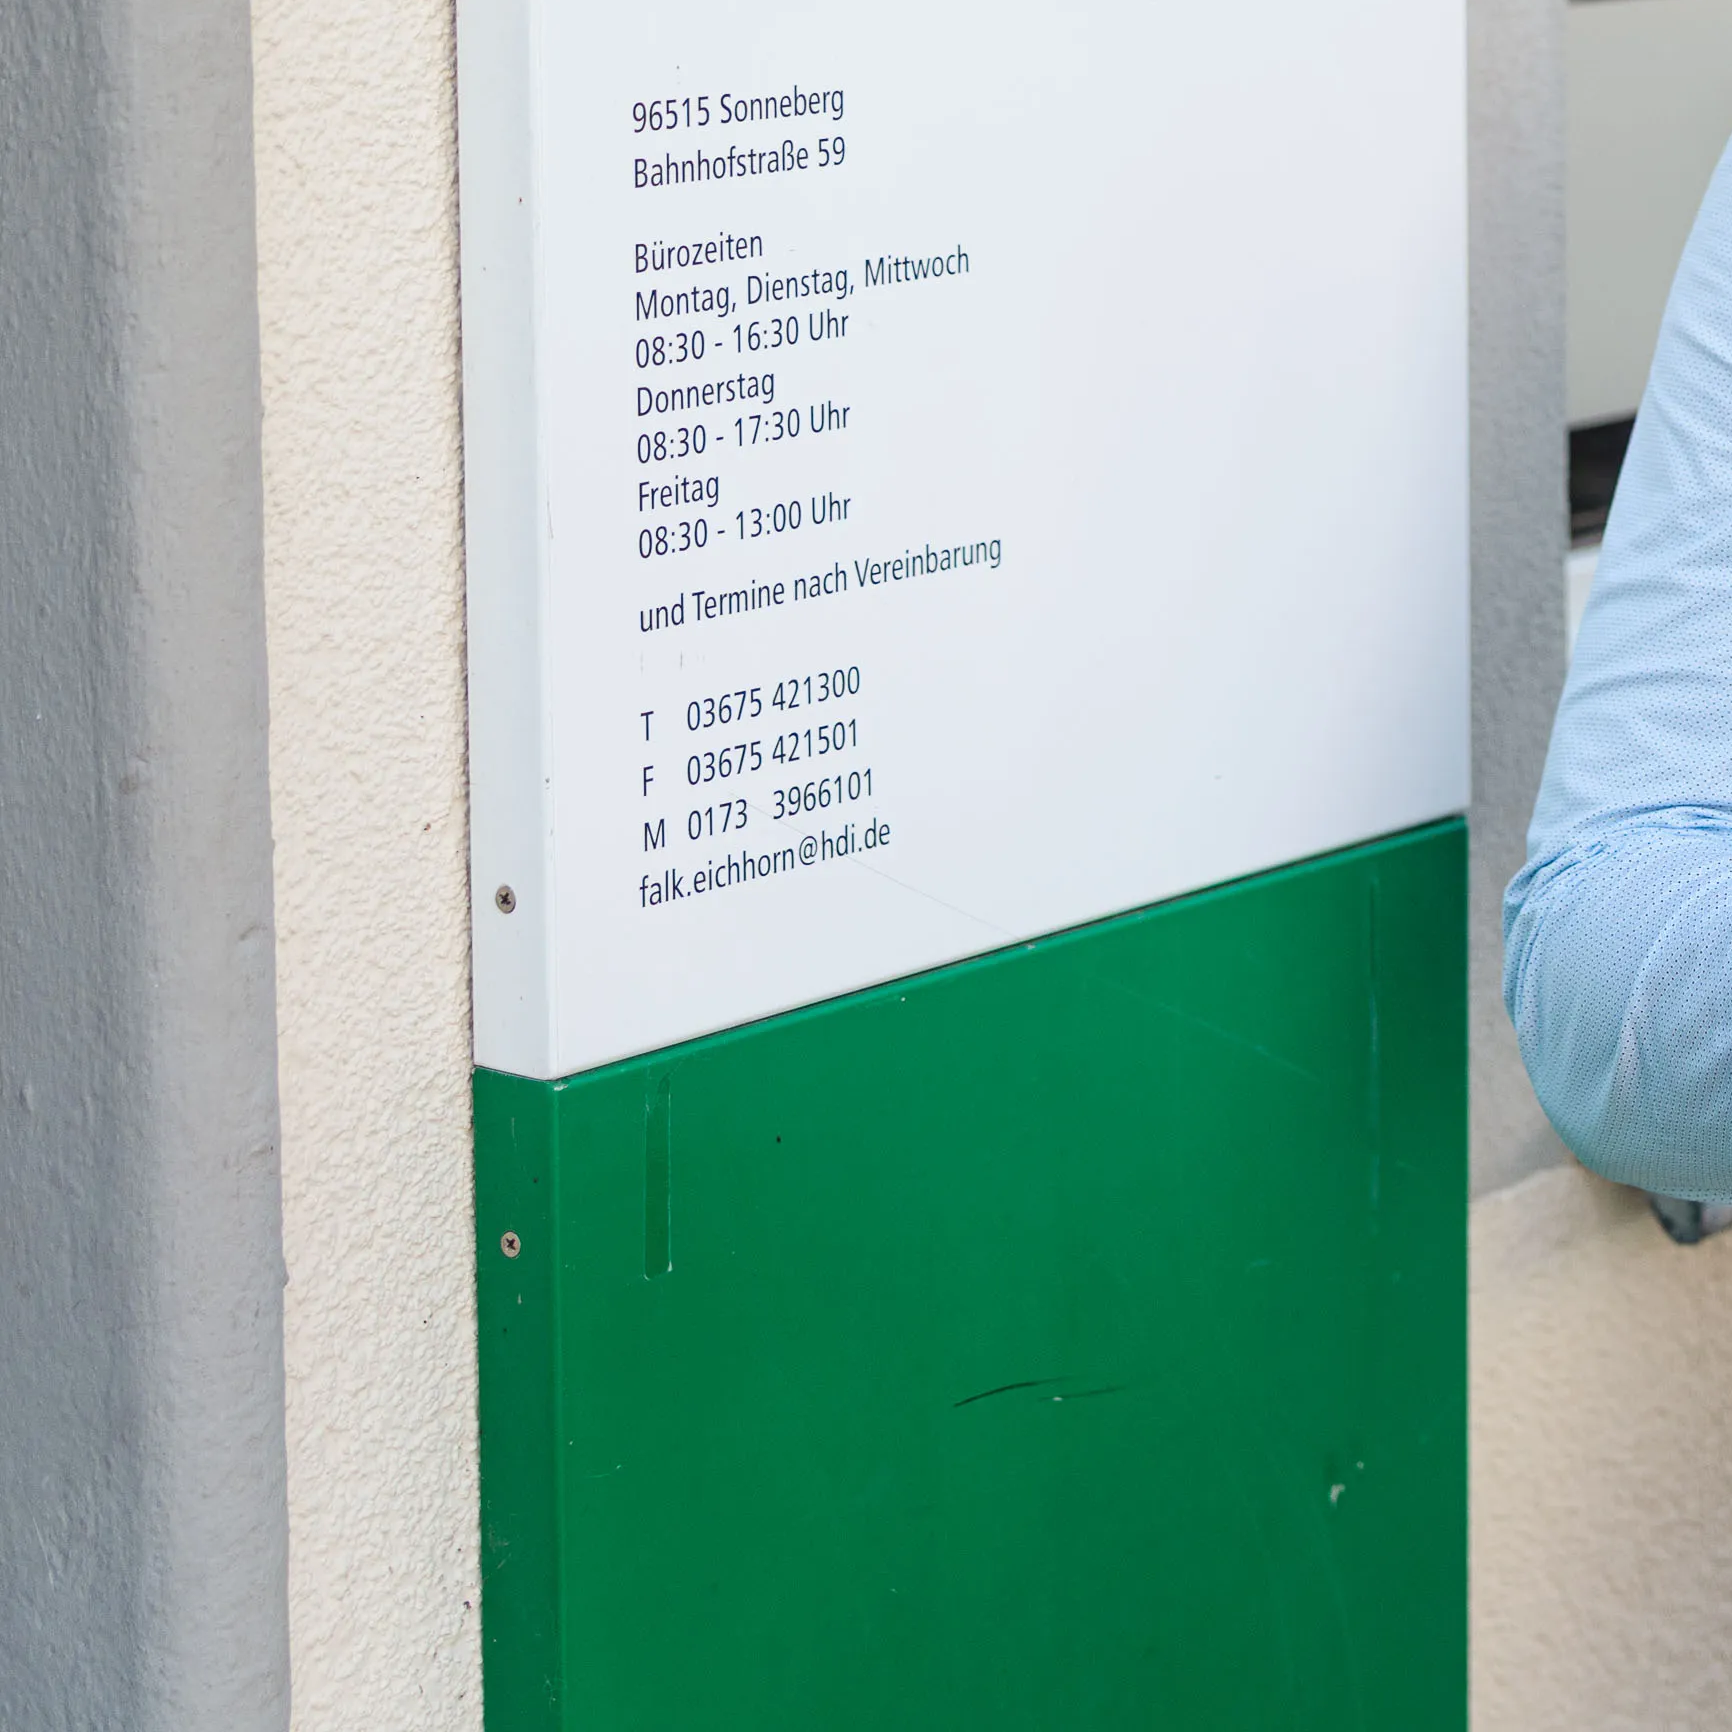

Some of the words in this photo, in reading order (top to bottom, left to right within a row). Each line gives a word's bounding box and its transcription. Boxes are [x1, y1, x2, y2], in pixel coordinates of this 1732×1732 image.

[632, 95, 710, 134] 96515
[720, 84, 845, 124] Sonneberg
[634, 139, 809, 189] Bahnhofstraße
[818, 136, 847, 168] 59
[635, 232, 763, 274] Bürozeiten
[636, 284, 737, 322] Montag,
[747, 268, 854, 305] Dienstag,
[865, 244, 970, 288] Mittwoch
[635, 329, 705, 369] 08:30
[733, 315, 799, 353] 16:30
[809, 308, 849, 342] Uhr
[637, 372, 775, 417] Donnerstag
[637, 424, 707, 464] 08:30
[734, 408, 801, 447] 17:30
[810, 400, 851, 434] Uhr
[638, 474, 719, 512] Freitag
[638, 518, 708, 559] 08:30
[735, 500, 802, 540] 13:00
[811, 491, 851, 525] Uhr
[640, 592, 685, 633] und
[691, 578, 785, 621] Termine
[794, 561, 848, 601] nach
[854, 538, 1001, 588] Vereinbarung
[640, 710, 655, 742] T
[686, 687, 763, 732] 03675
[772, 666, 861, 711] 421300
[642, 765, 654, 797] F
[687, 740, 763, 786] 03675
[772, 718, 858, 764] 421501
[644, 818, 666, 852] M
[687, 798, 749, 841] 0173
[772, 767, 873, 820] 3966101
[639, 816, 891, 908] falk.eichhorn@hdi.de
